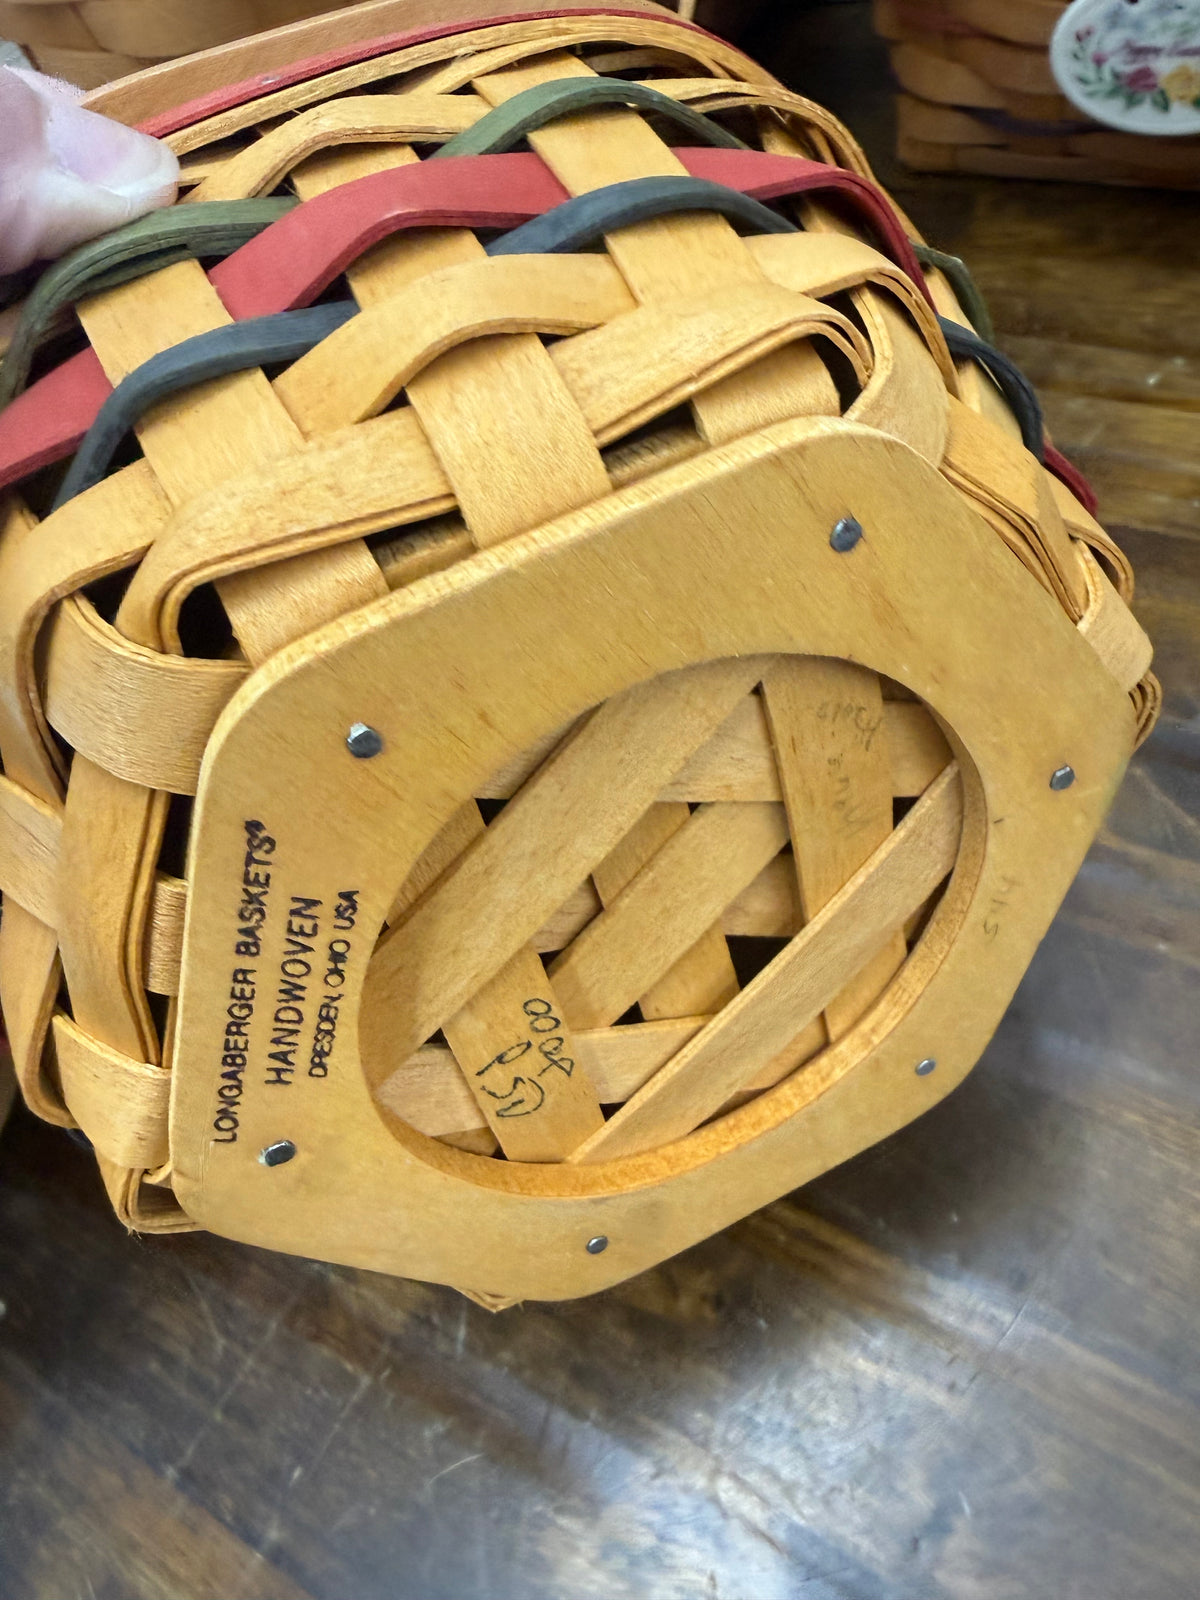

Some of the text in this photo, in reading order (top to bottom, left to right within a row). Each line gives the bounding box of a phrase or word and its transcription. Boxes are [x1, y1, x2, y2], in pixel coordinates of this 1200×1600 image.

[324, 938, 351, 988] OHIO
[333, 890, 360, 931] USA
[264, 896, 323, 1085] HANDWOVEN
[213, 967, 257, 1143] LONGABERGER
